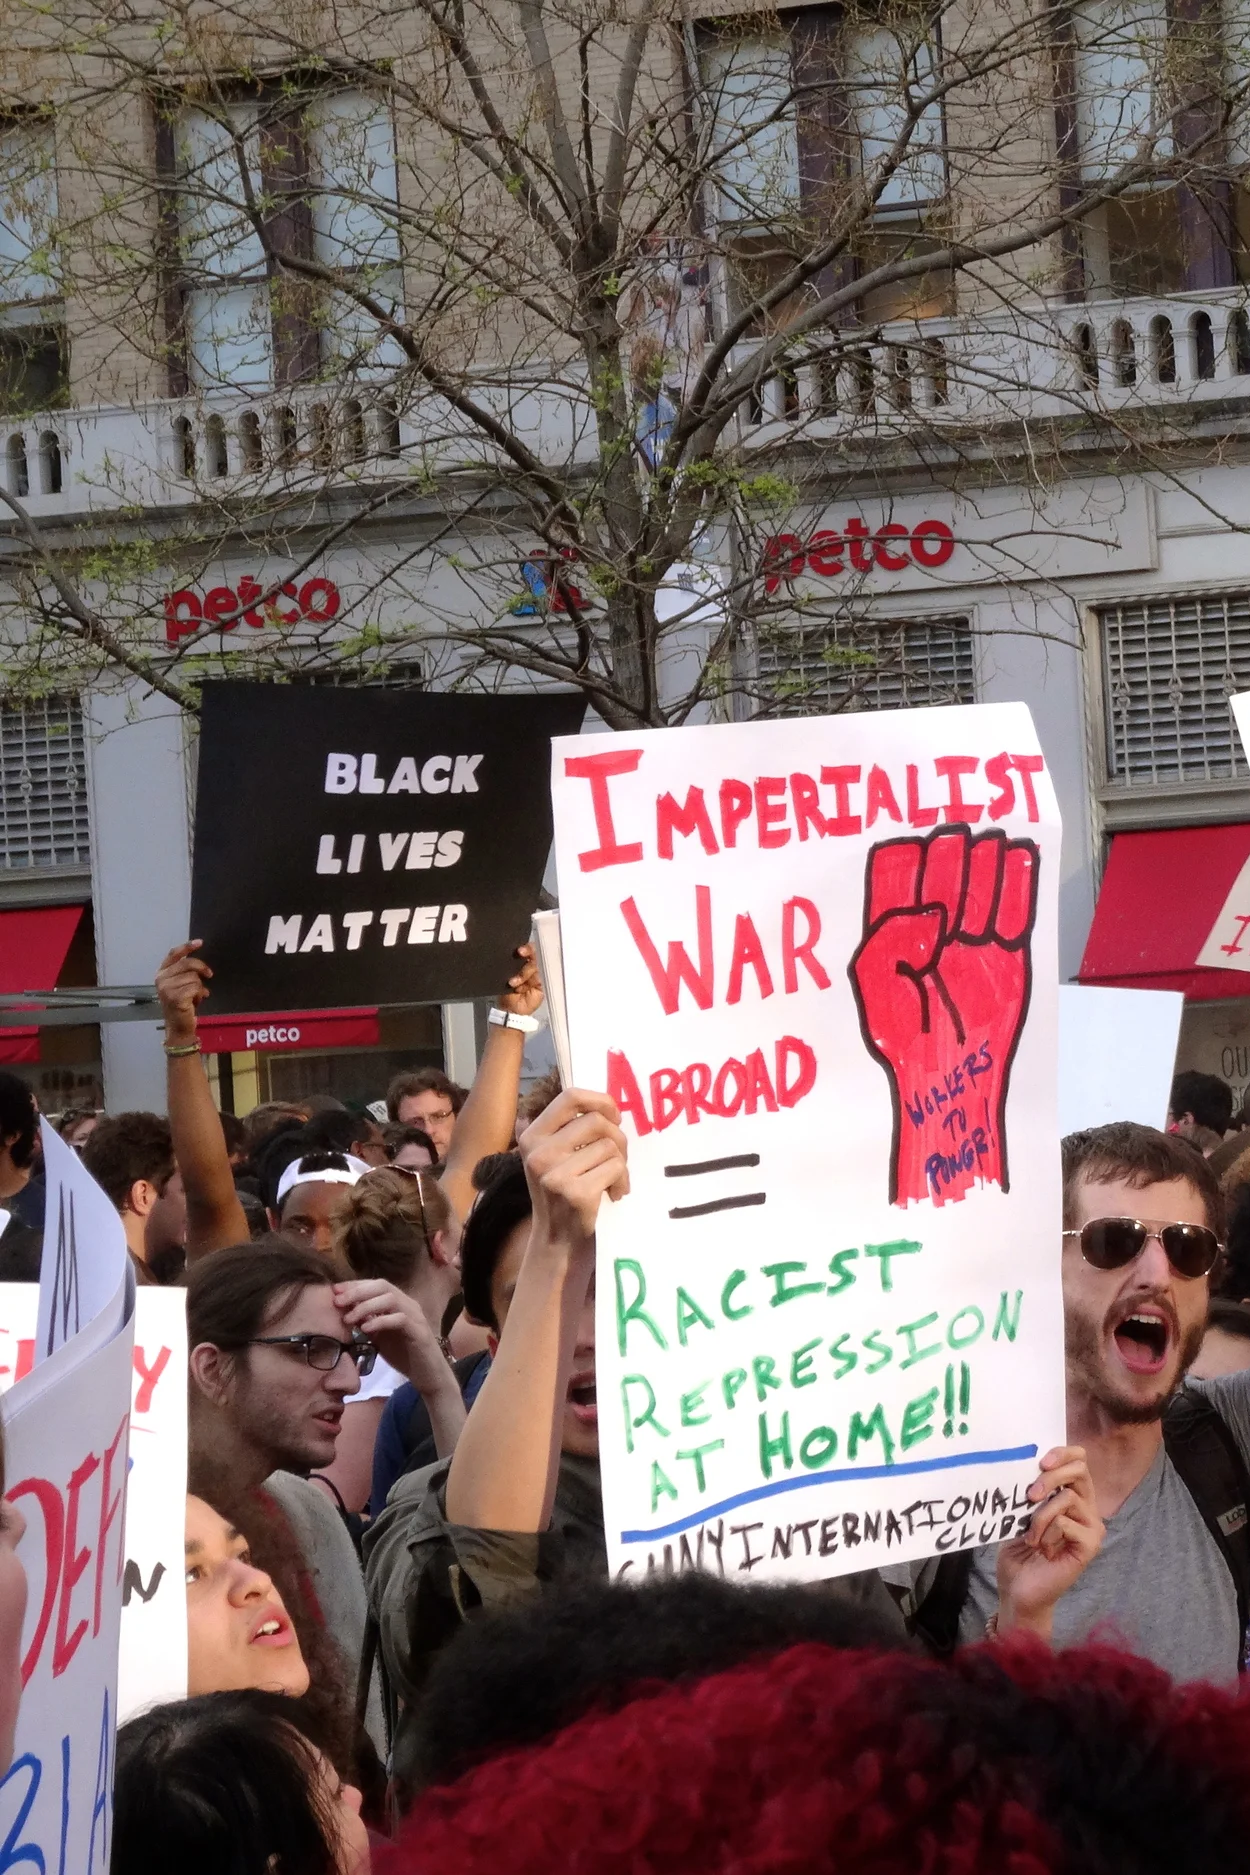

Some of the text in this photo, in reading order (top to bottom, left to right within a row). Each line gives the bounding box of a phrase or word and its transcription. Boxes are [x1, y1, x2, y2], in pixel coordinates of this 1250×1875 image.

[763, 517, 954, 595] petco
[164, 575, 341, 650] petco
[324, 752, 484, 795] BLACK
[564, 749, 1044, 873] IMPERIALIST
[316, 830, 465, 875] LIVES
[265, 904, 469, 954] MATTER
[619, 884, 832, 1016] WAR
[246, 1025, 300, 1048] petco
[606, 1035, 817, 1137] ABROAD
[904, 1039, 993, 1129] WORKERS
[942, 1105, 967, 1142] TO
[613, 1238, 923, 1357] RACIST
[620, 1289, 1024, 1454] REPRESSION
[758, 1361, 972, 1479] HOME!!
[651, 1438, 725, 1514] AT
[729, 1483, 1037, 1572] INTERNATIONAL
[934, 1513, 1032, 1551] CLUBS
